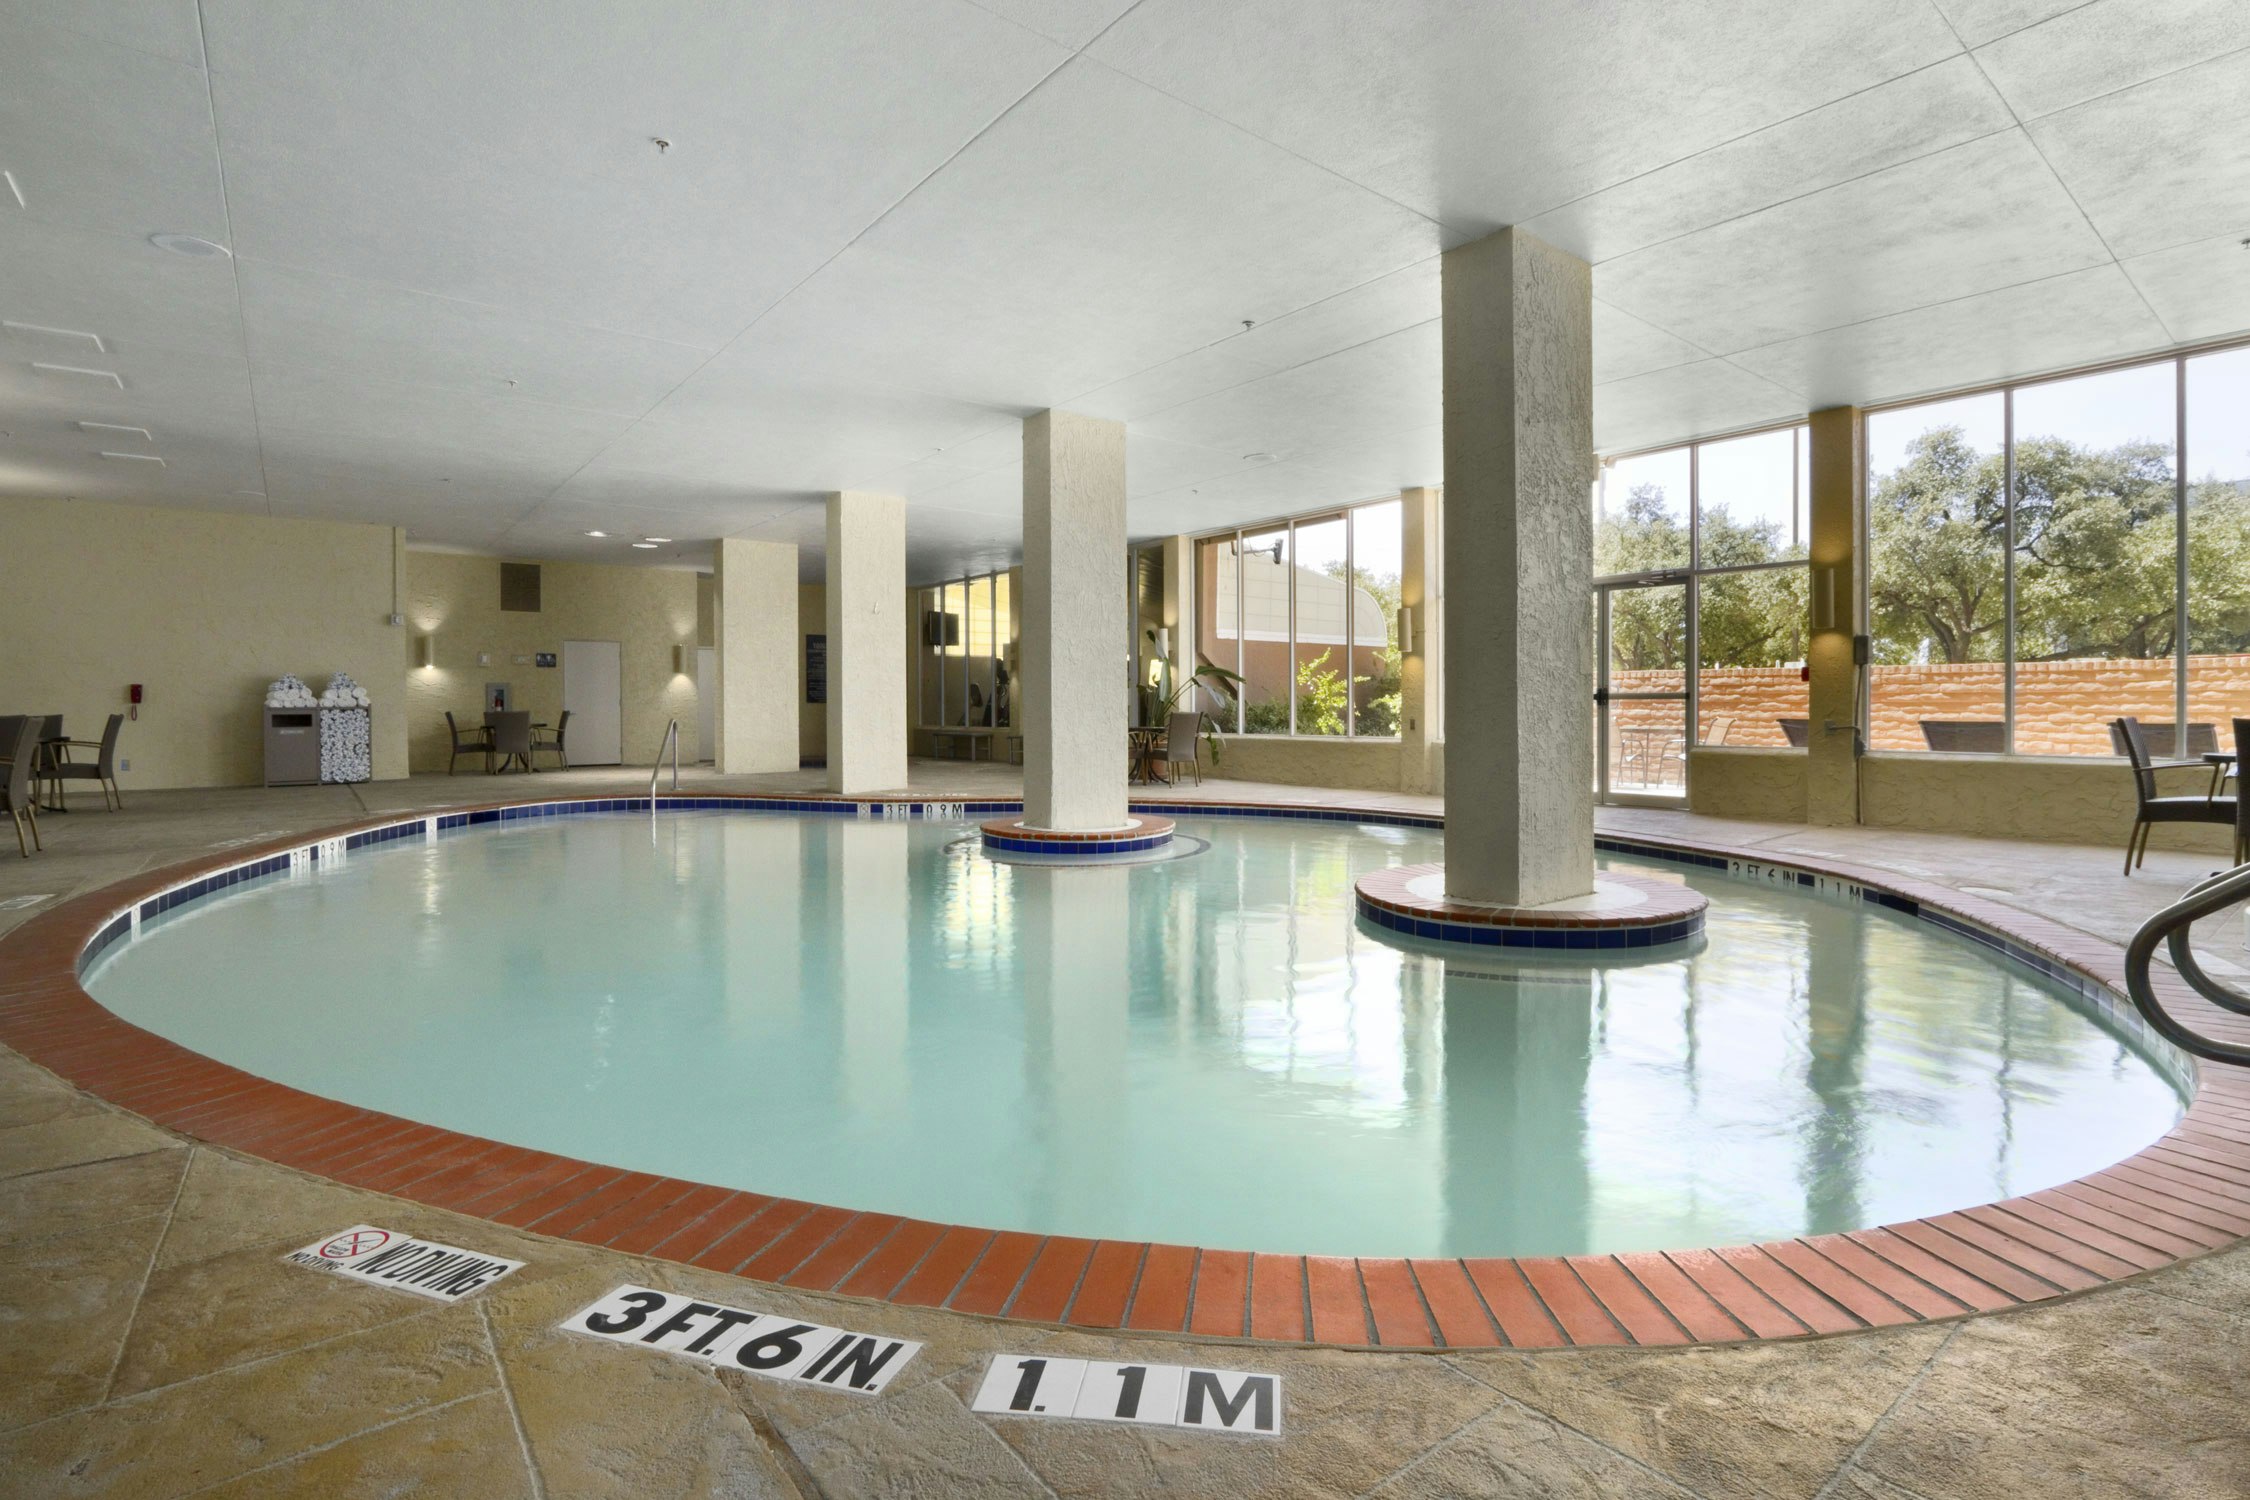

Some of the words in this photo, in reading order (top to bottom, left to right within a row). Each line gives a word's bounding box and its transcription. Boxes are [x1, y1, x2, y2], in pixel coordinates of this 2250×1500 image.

[349, 1242, 428, 1274] NO
[381, 1250, 508, 1296] DIVING
[586, 1291, 667, 1334] 3
[736, 1324, 819, 1370] 6
